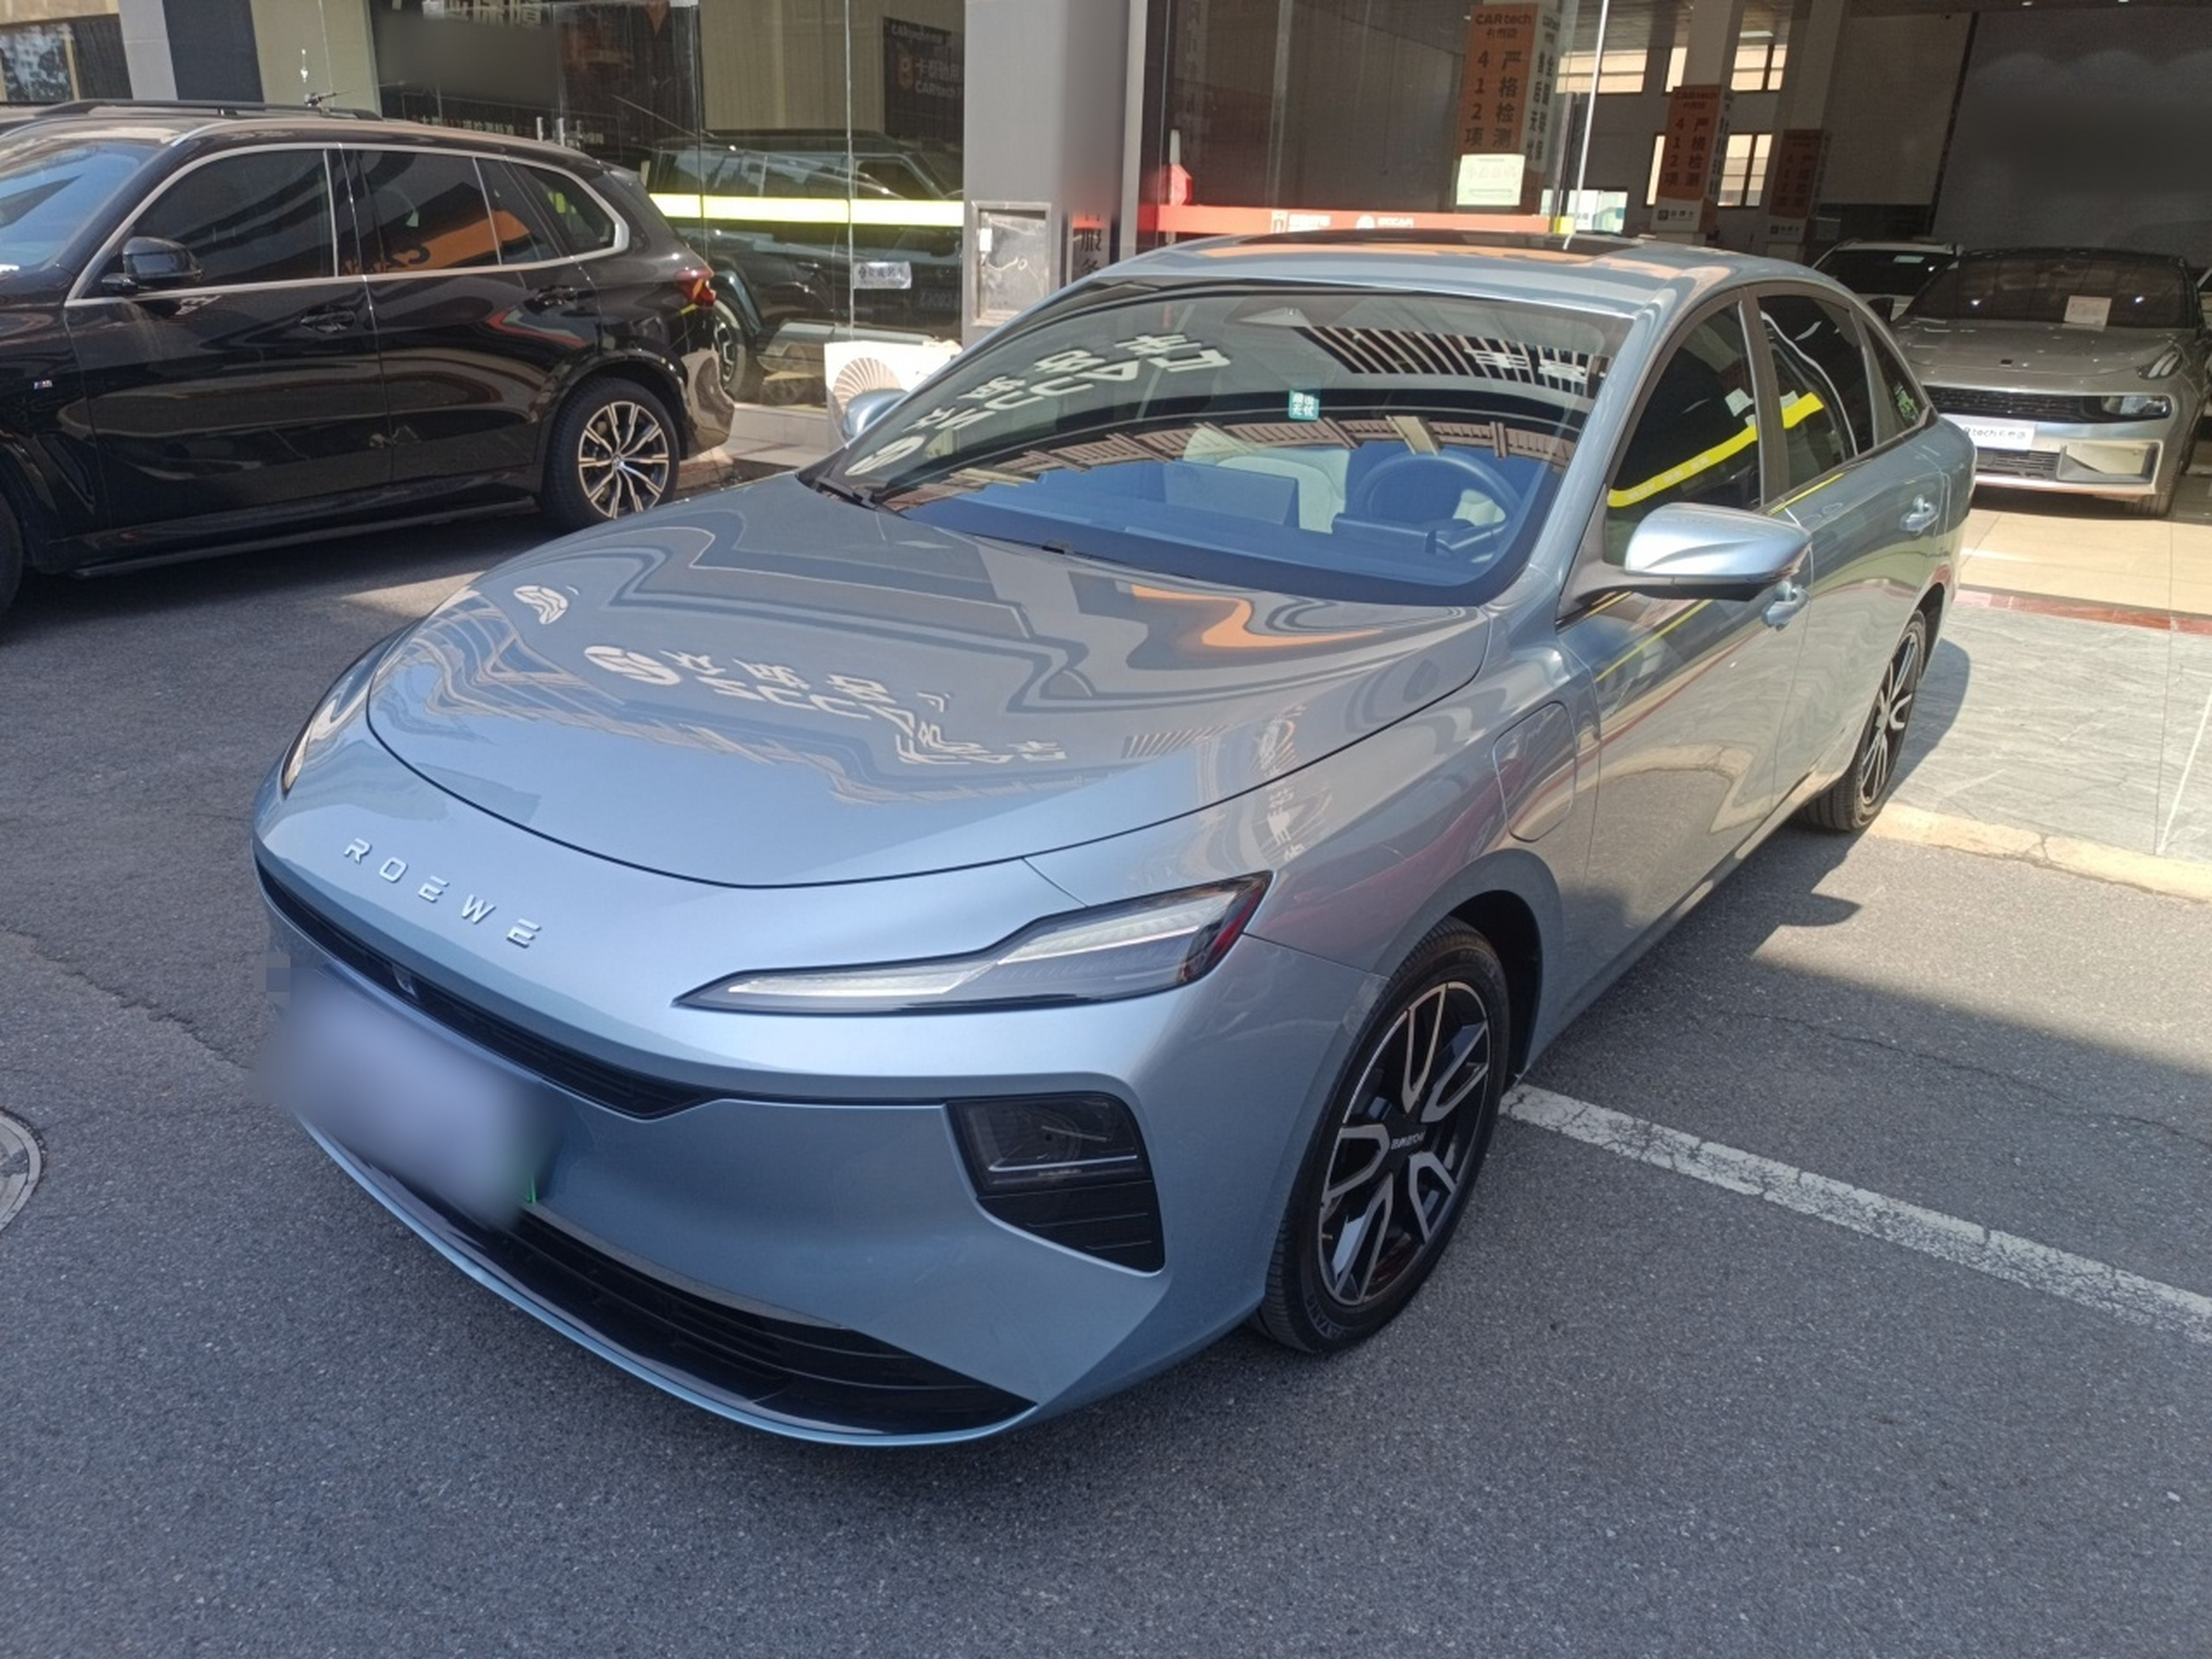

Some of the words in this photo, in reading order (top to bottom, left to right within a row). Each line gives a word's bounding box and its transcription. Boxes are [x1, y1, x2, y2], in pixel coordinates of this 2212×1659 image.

[1475, 14, 1532, 25] CARtech
[1464, 50, 1490, 147] 412项
[1493, 51, 1521, 149] 严格检测
[343, 837, 541, 949] ROEWE
